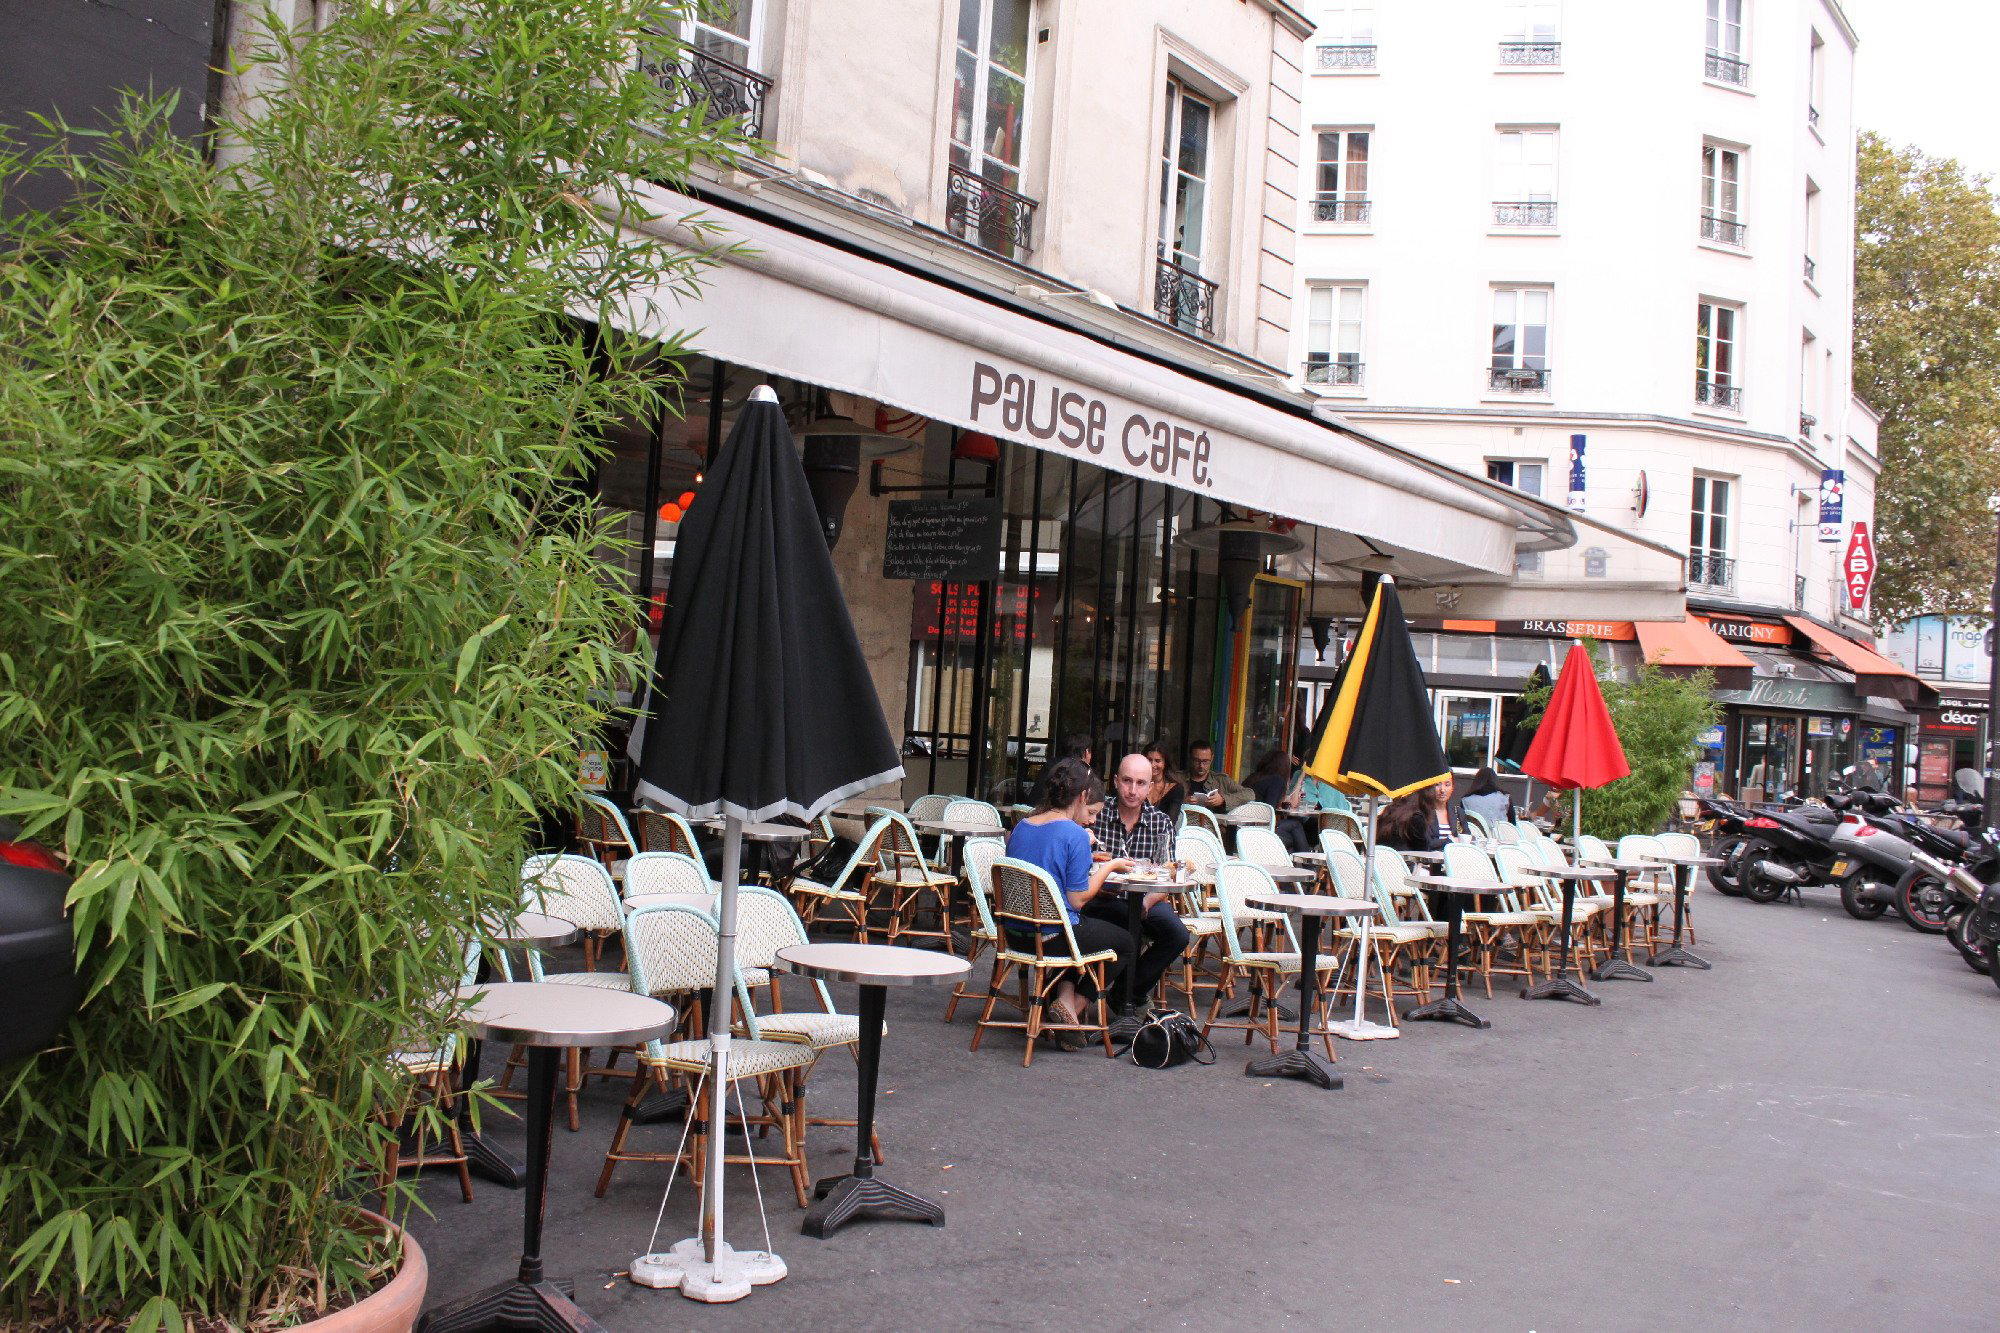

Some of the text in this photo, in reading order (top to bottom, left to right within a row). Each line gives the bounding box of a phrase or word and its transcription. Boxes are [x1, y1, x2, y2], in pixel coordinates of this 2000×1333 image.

[1850, 533, 1869, 598] TABAC
[1523, 620, 1613, 637] BRASSERIE
[1707, 622, 1776, 640] MARIGNY
